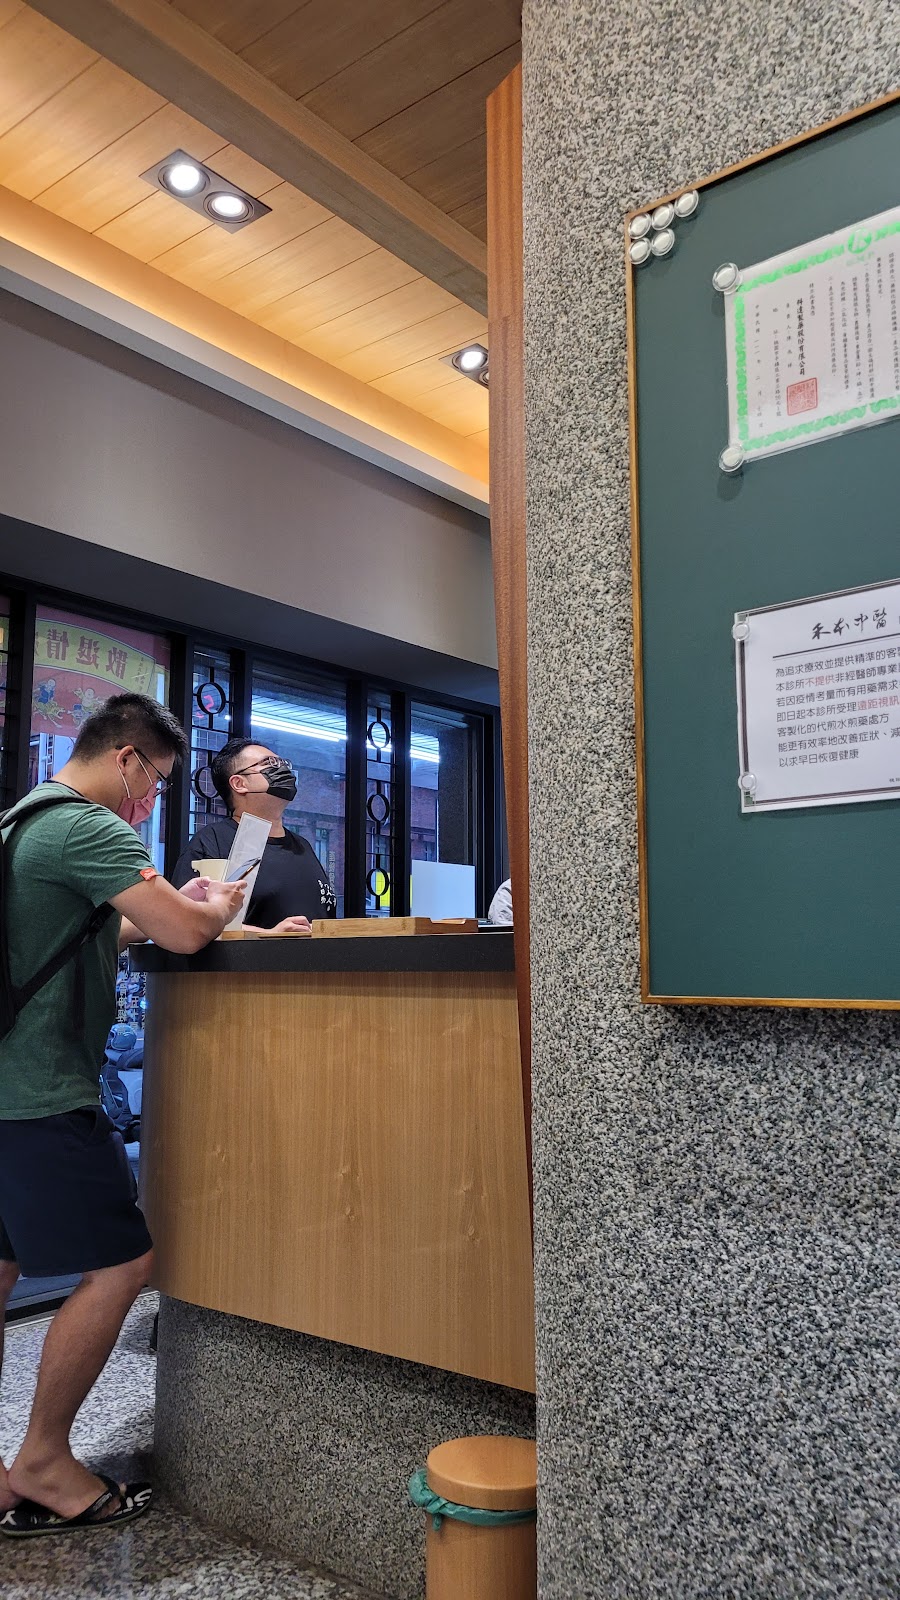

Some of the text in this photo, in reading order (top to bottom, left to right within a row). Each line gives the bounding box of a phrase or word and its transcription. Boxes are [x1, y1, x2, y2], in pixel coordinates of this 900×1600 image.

[796, 298, 806, 376] 科達製藥股份有限公司
[775, 663, 900, 692] 本診所不提供非經醫師專業
[775, 679, 900, 707] 若因疫情考量而有用藥需求
[776, 695, 900, 723] 即日起本診所受理遠距視訊
[777, 713, 889, 738] 客製化的代煎水煎藥處方
[779, 748, 859, 768] 以求早日恢復健康
